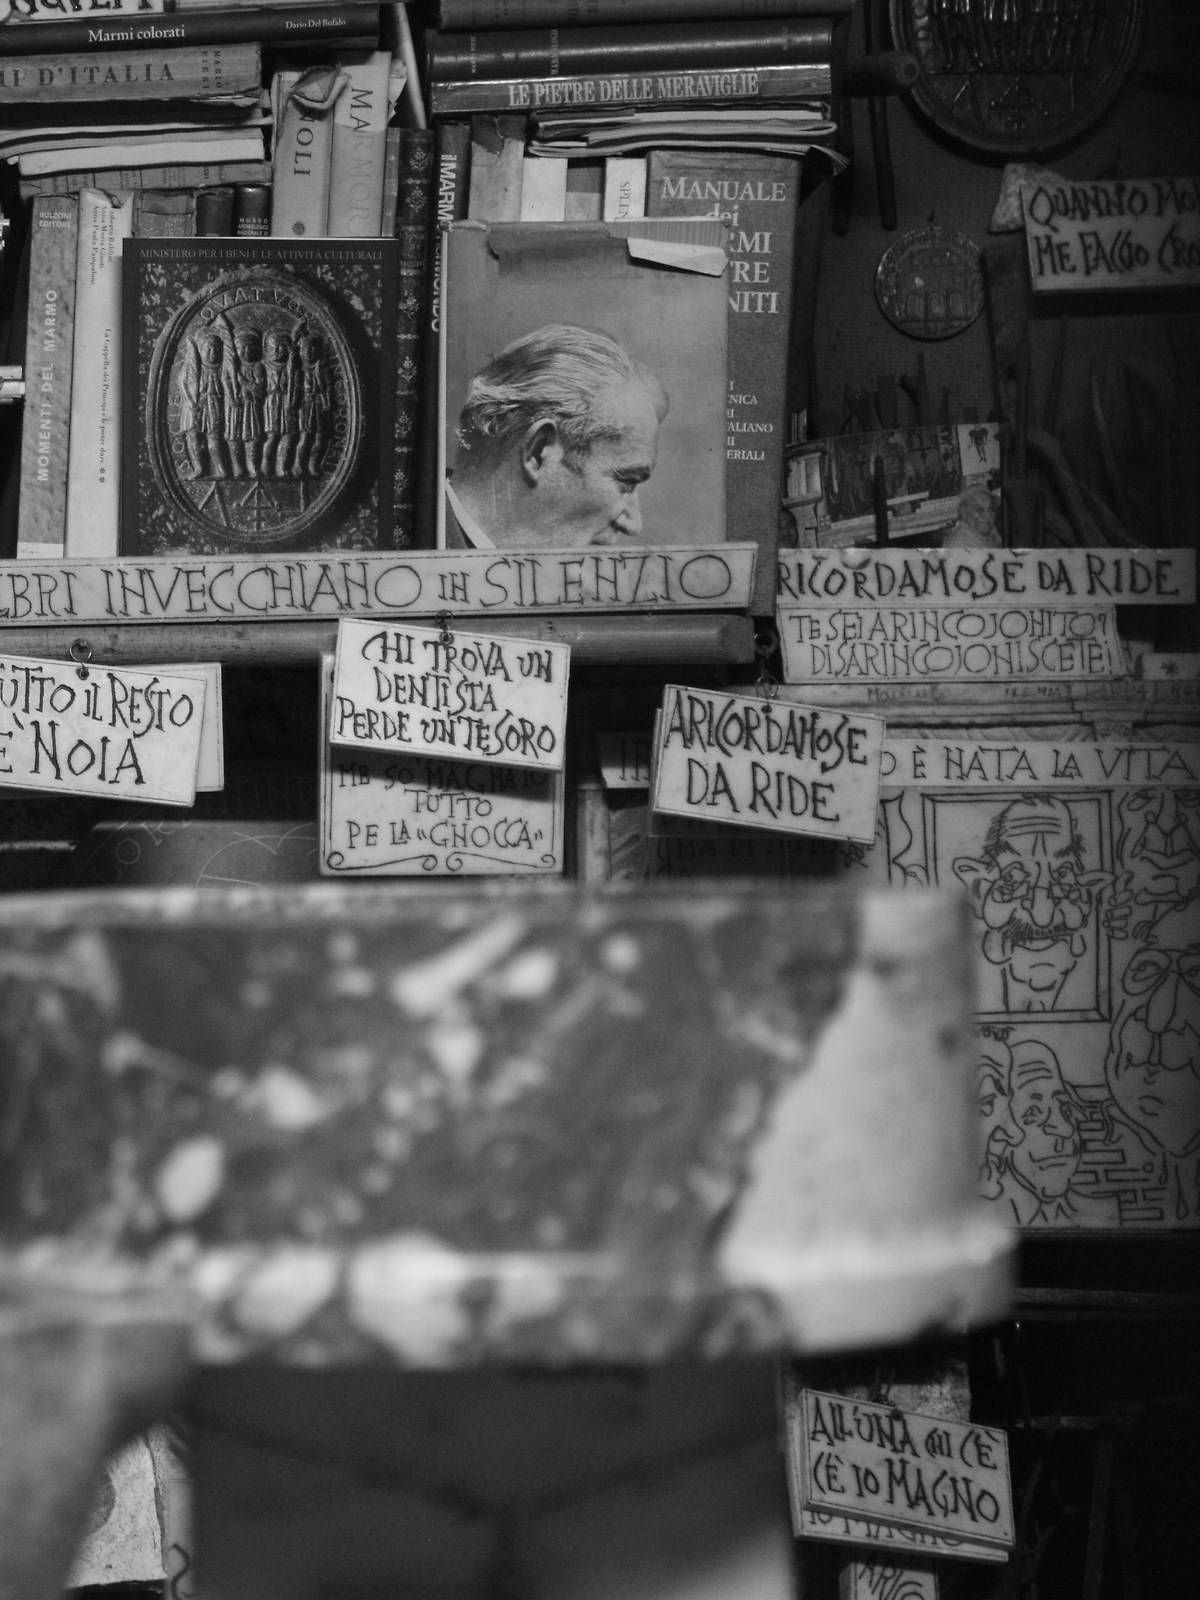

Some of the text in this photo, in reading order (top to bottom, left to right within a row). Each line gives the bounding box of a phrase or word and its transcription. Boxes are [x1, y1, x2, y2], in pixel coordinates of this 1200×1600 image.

[88, 25, 185, 43] Marmi colorati
[285, 17, 346, 30] Dario Del Bufalo
[39, 62, 175, 87] D'ITALIA
[201, 50, 210, 90] PIERI
[212, 50, 221, 89] MARIO
[509, 73, 759, 107] LE PIETRE DELLE MERAVIGLIE
[660, 176, 786, 202] MANUALE
[39, 220, 72, 229] EDITORE
[140, 249, 383, 260] MINISTERO PER BENI E LE ATTIVITÀ CULTURALI
[1034, 234, 1076, 276] ME
[102, 339, 111, 370] Cappella
[38, 289, 57, 482] MOMENTI DEL MARMO
[100, 562, 422, 616] INVECCHIANO
[438, 570, 470, 603] IN
[479, 554, 731, 608] SILENZIO
[1038, 558, 1077, 596] DA
[1086, 553, 1179, 597] RIDE
[788, 614, 820, 643] TE
[362, 630, 554, 683] CHI TROVA UN
[83, 682, 103, 721] IL
[107, 673, 194, 739] RESTO
[373, 666, 498, 717] DENTISTA
[336, 695, 556, 759] PERDE UN TESORO
[664, 690, 868, 774] ARICORDAMOSE
[30, 721, 146, 785] NOIA
[944, 745, 1038, 781] NATA
[1052, 749, 1082, 779] LA
[1094, 745, 1198, 781] VITA
[403, 788, 493, 821] TUTTO
[687, 758, 740, 813] DA
[749, 760, 839, 823] RIDE
[347, 819, 411, 849] PE LA
[811, 1396, 953, 1459] ALL'UNA CHI
[852, 1457, 999, 1524] IO MAGNO
